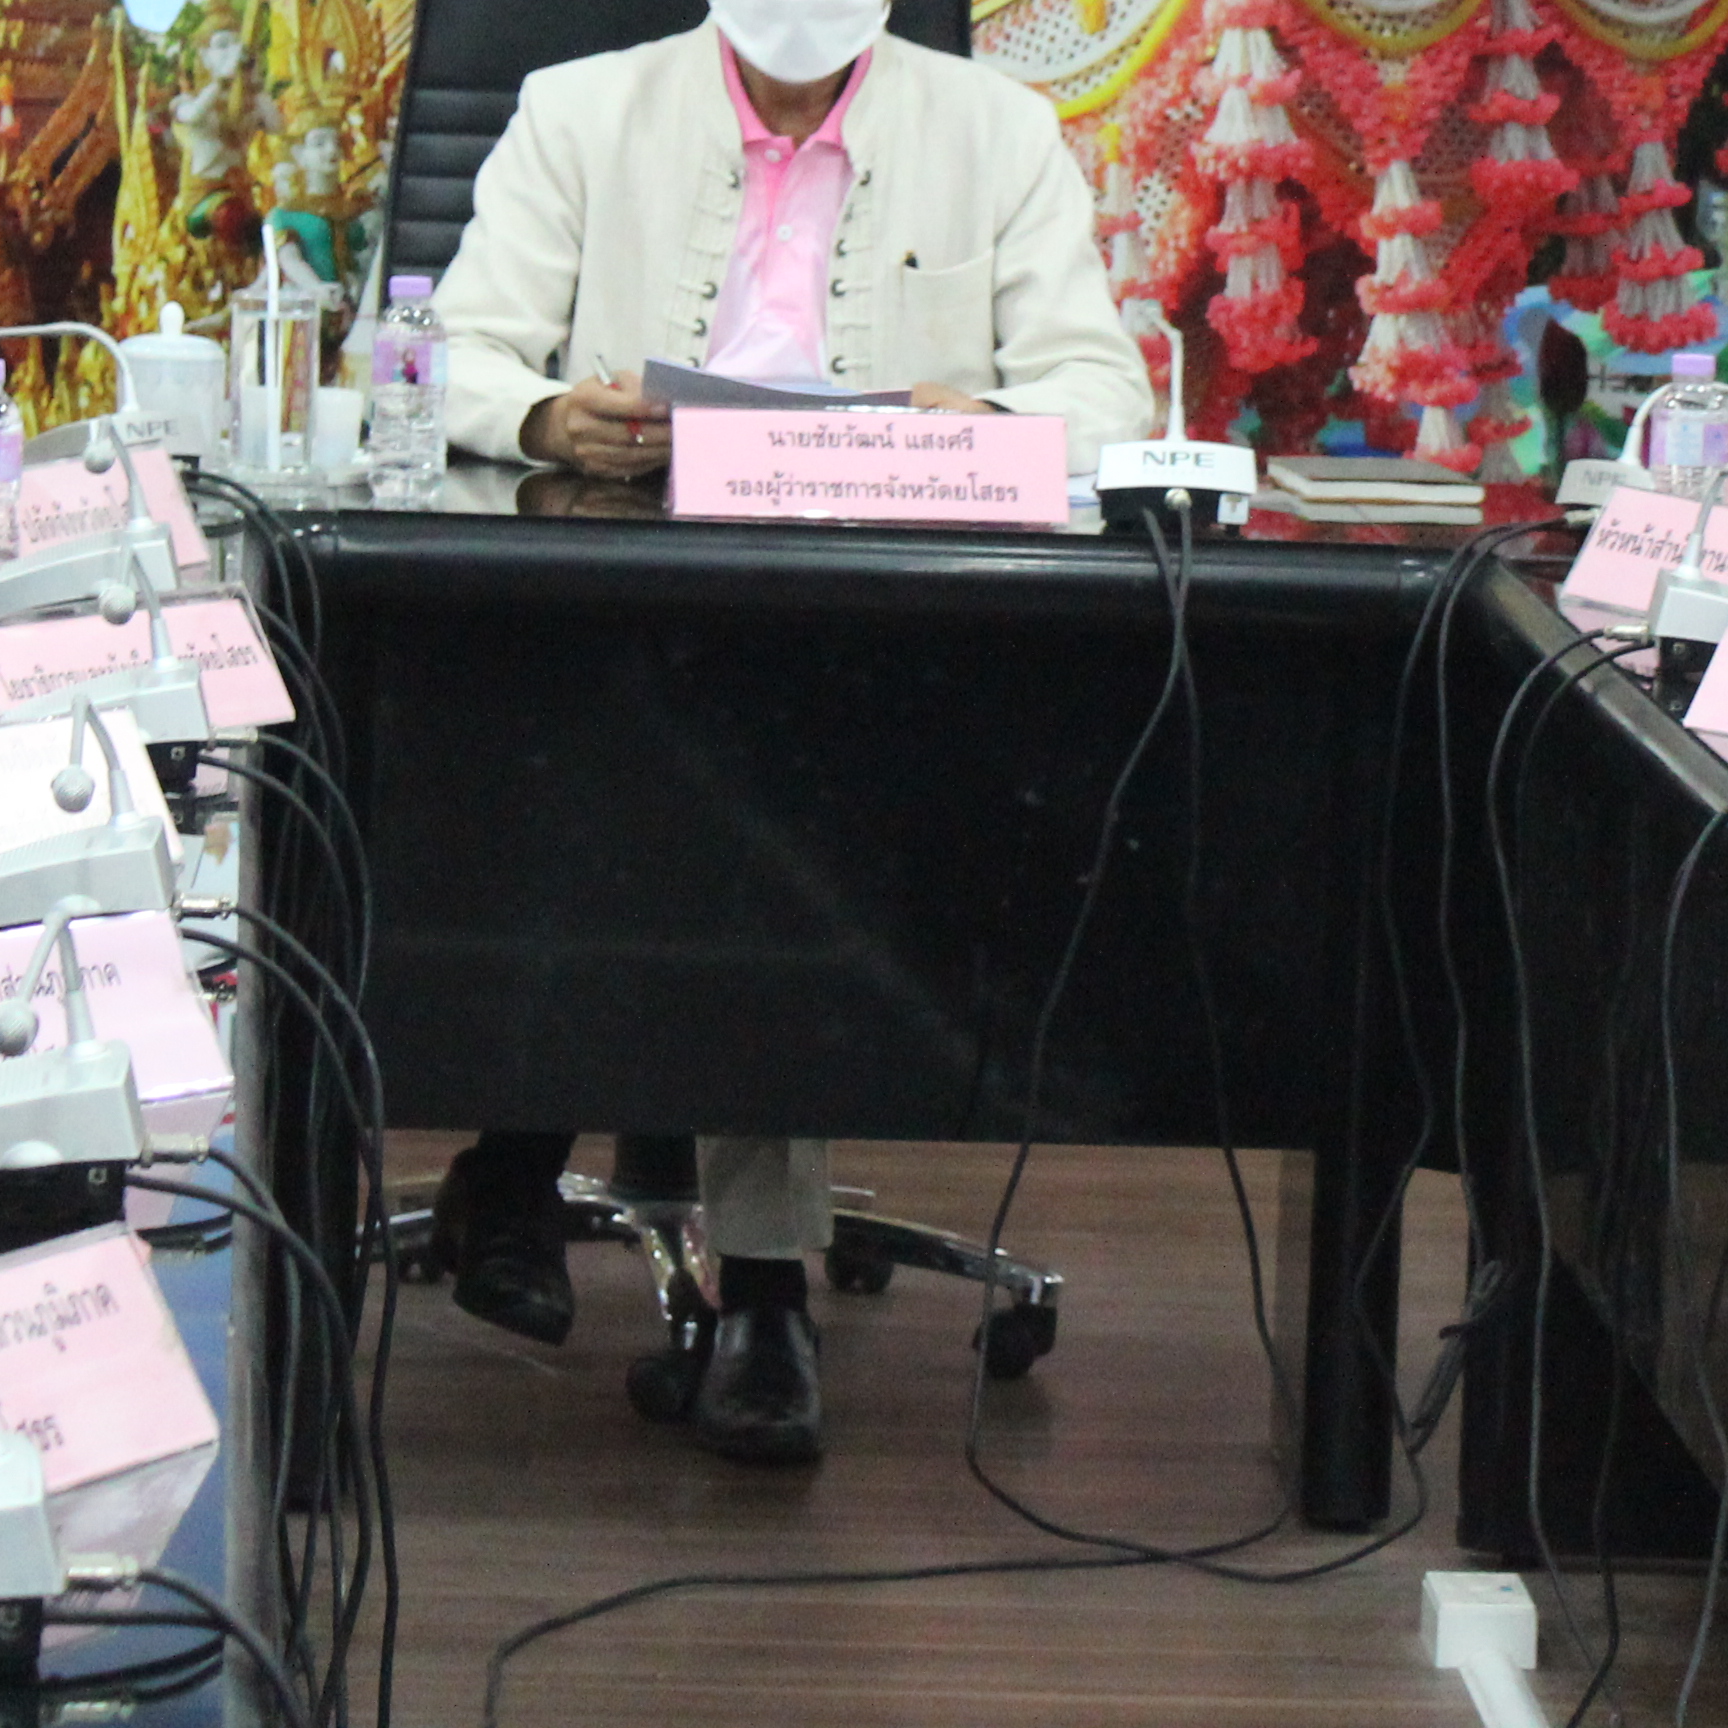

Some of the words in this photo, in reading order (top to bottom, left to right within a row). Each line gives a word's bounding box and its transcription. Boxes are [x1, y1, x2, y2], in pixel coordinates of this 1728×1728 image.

[768, 422, 894, 450] นายชัยวัฒน์
[905, 425, 975, 451] แสงศรี
[1141, 449, 1215, 469] NPE
[725, 471, 1019, 506] รองผู้ว่าราชการจังหวัดยโสธร
